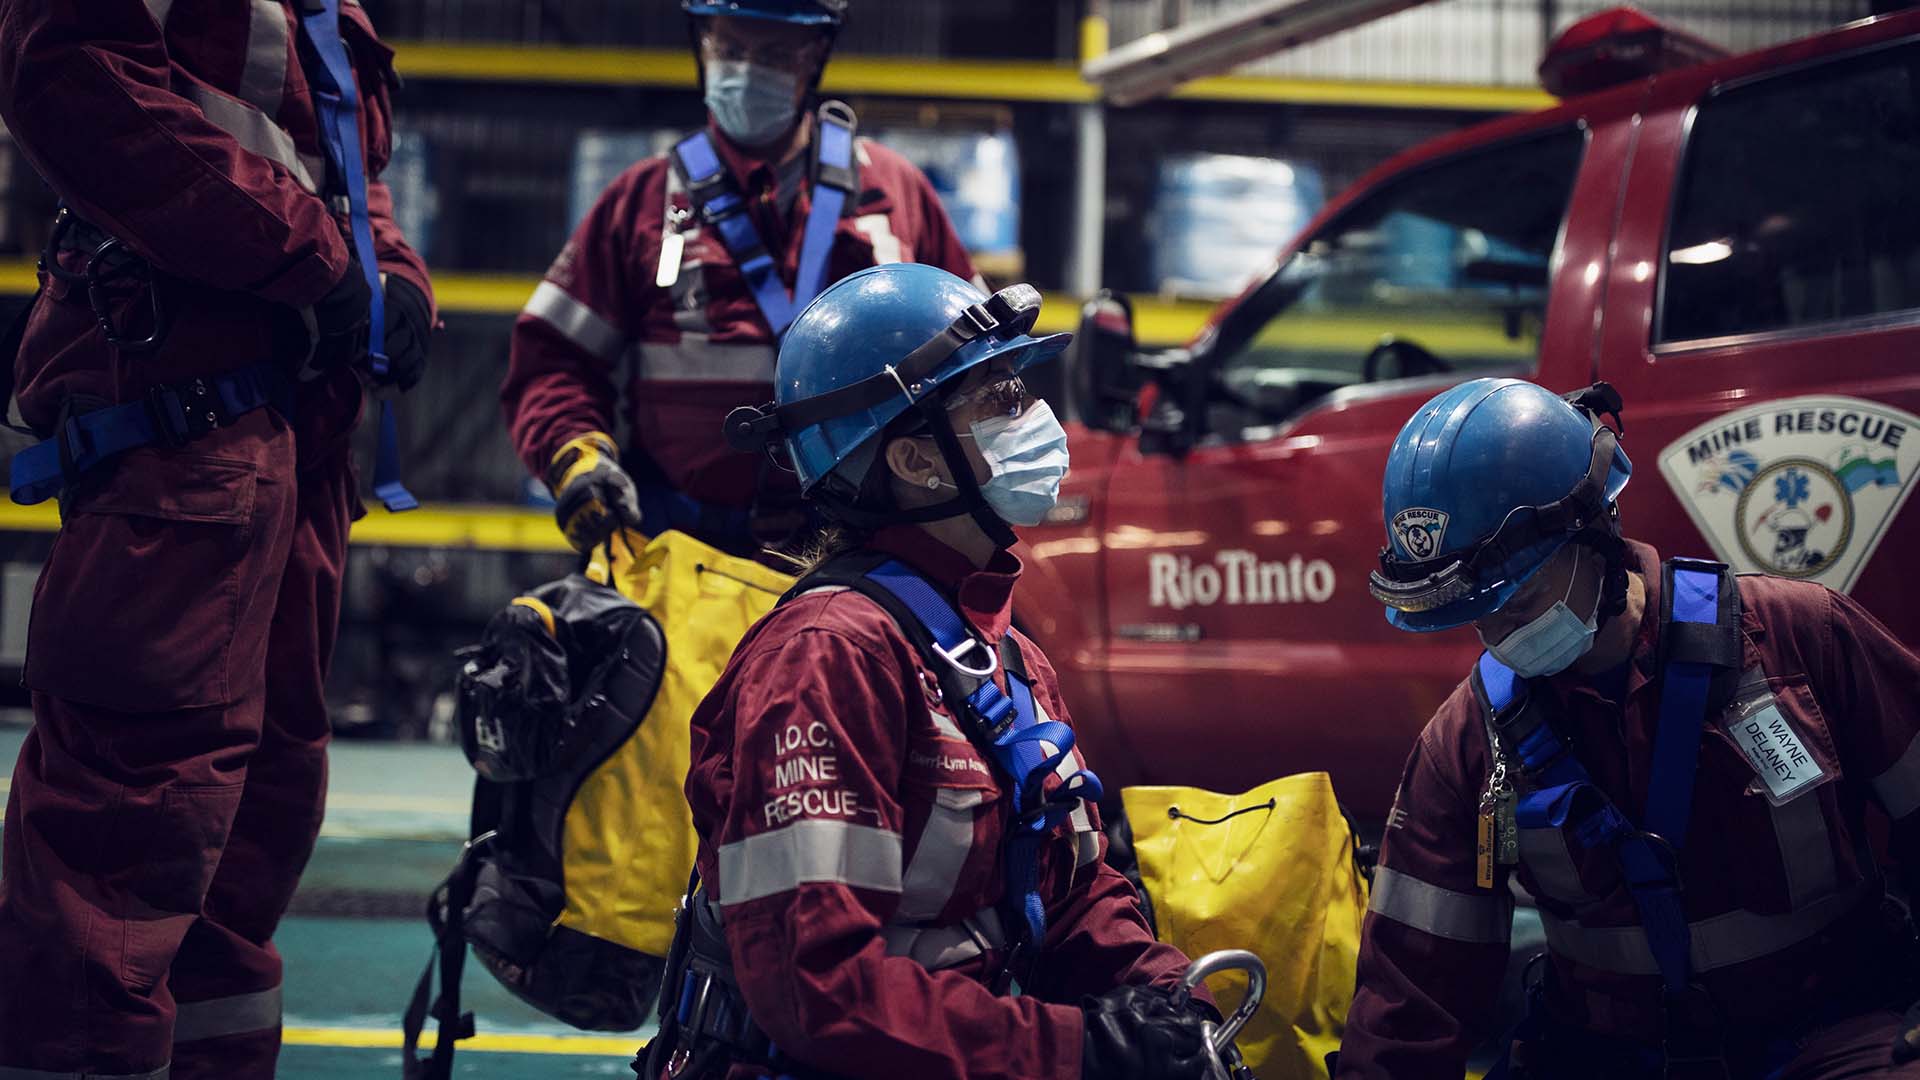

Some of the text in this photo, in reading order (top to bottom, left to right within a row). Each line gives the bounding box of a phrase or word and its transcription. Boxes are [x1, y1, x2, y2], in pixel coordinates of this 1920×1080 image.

[1688, 411, 1906, 464] MINE RESCUE
[1407, 511, 1439, 520] RESCUE
[775, 721, 835, 756] I.O.C.
[1745, 722, 1796, 782] DELANEY
[1769, 719, 1808, 768] WAYNE
[775, 756, 838, 790] MINE
[764, 788, 858, 828] RESCUE
